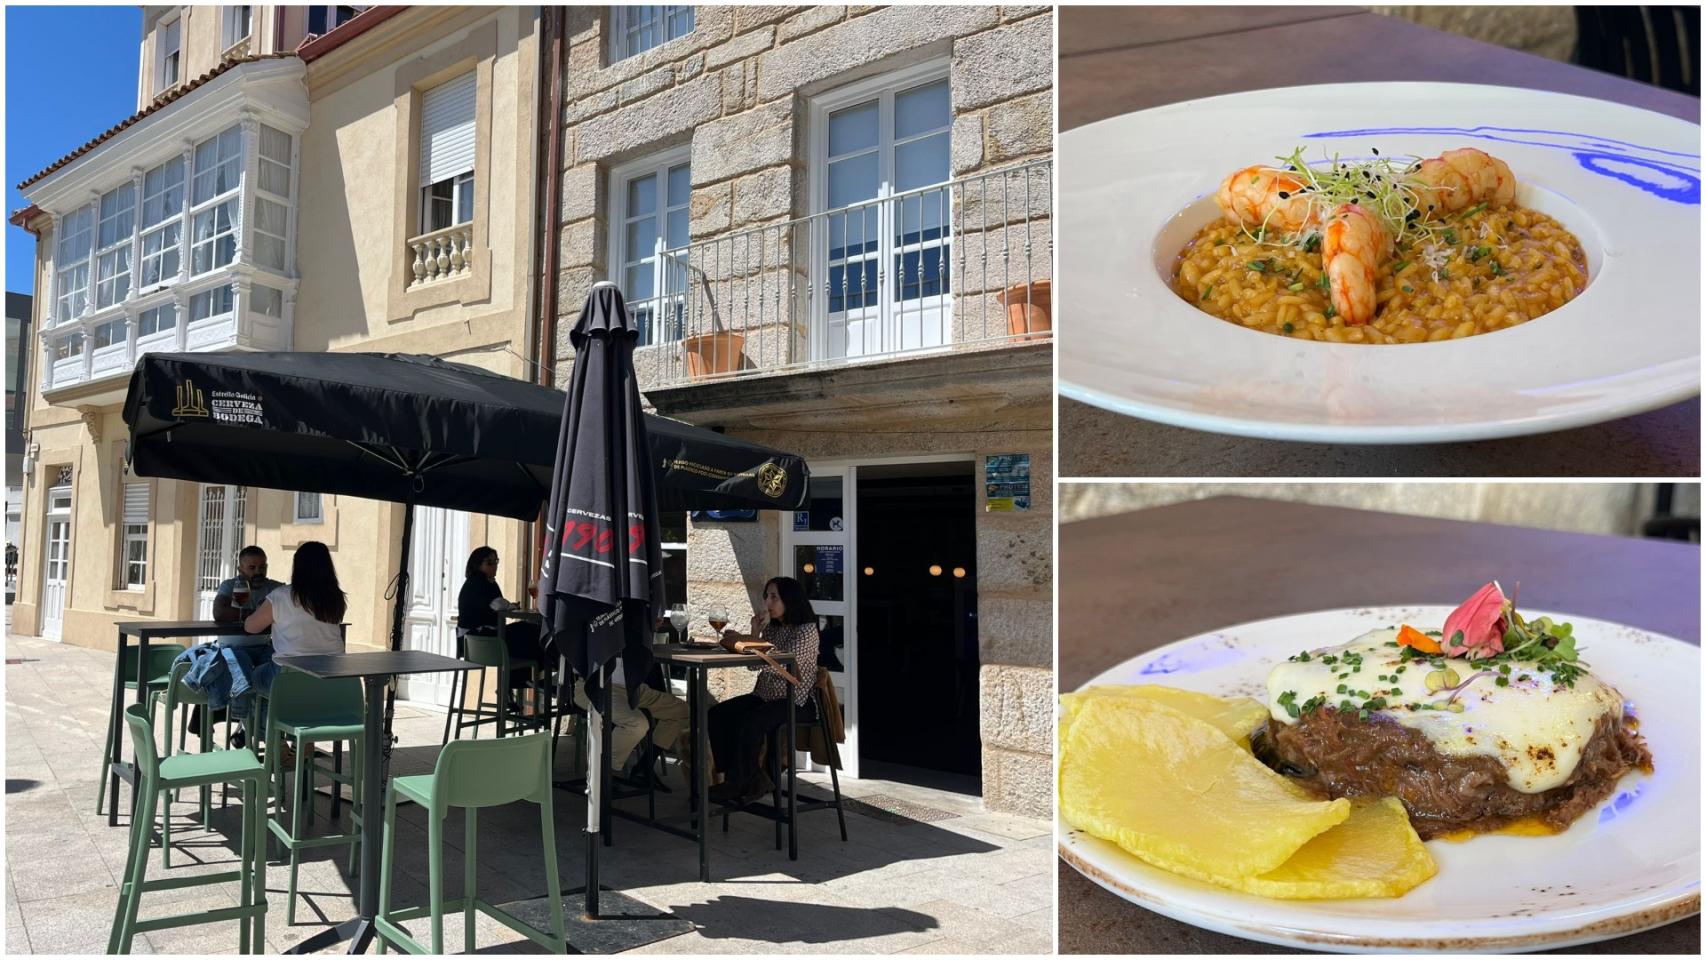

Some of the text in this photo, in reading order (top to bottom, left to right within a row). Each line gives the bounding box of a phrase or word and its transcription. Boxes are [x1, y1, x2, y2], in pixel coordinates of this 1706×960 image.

[211, 400, 263, 411] CERVEZA
[213, 412, 263, 424] BODEGA
[567, 507, 612, 522] CERVEZAS
